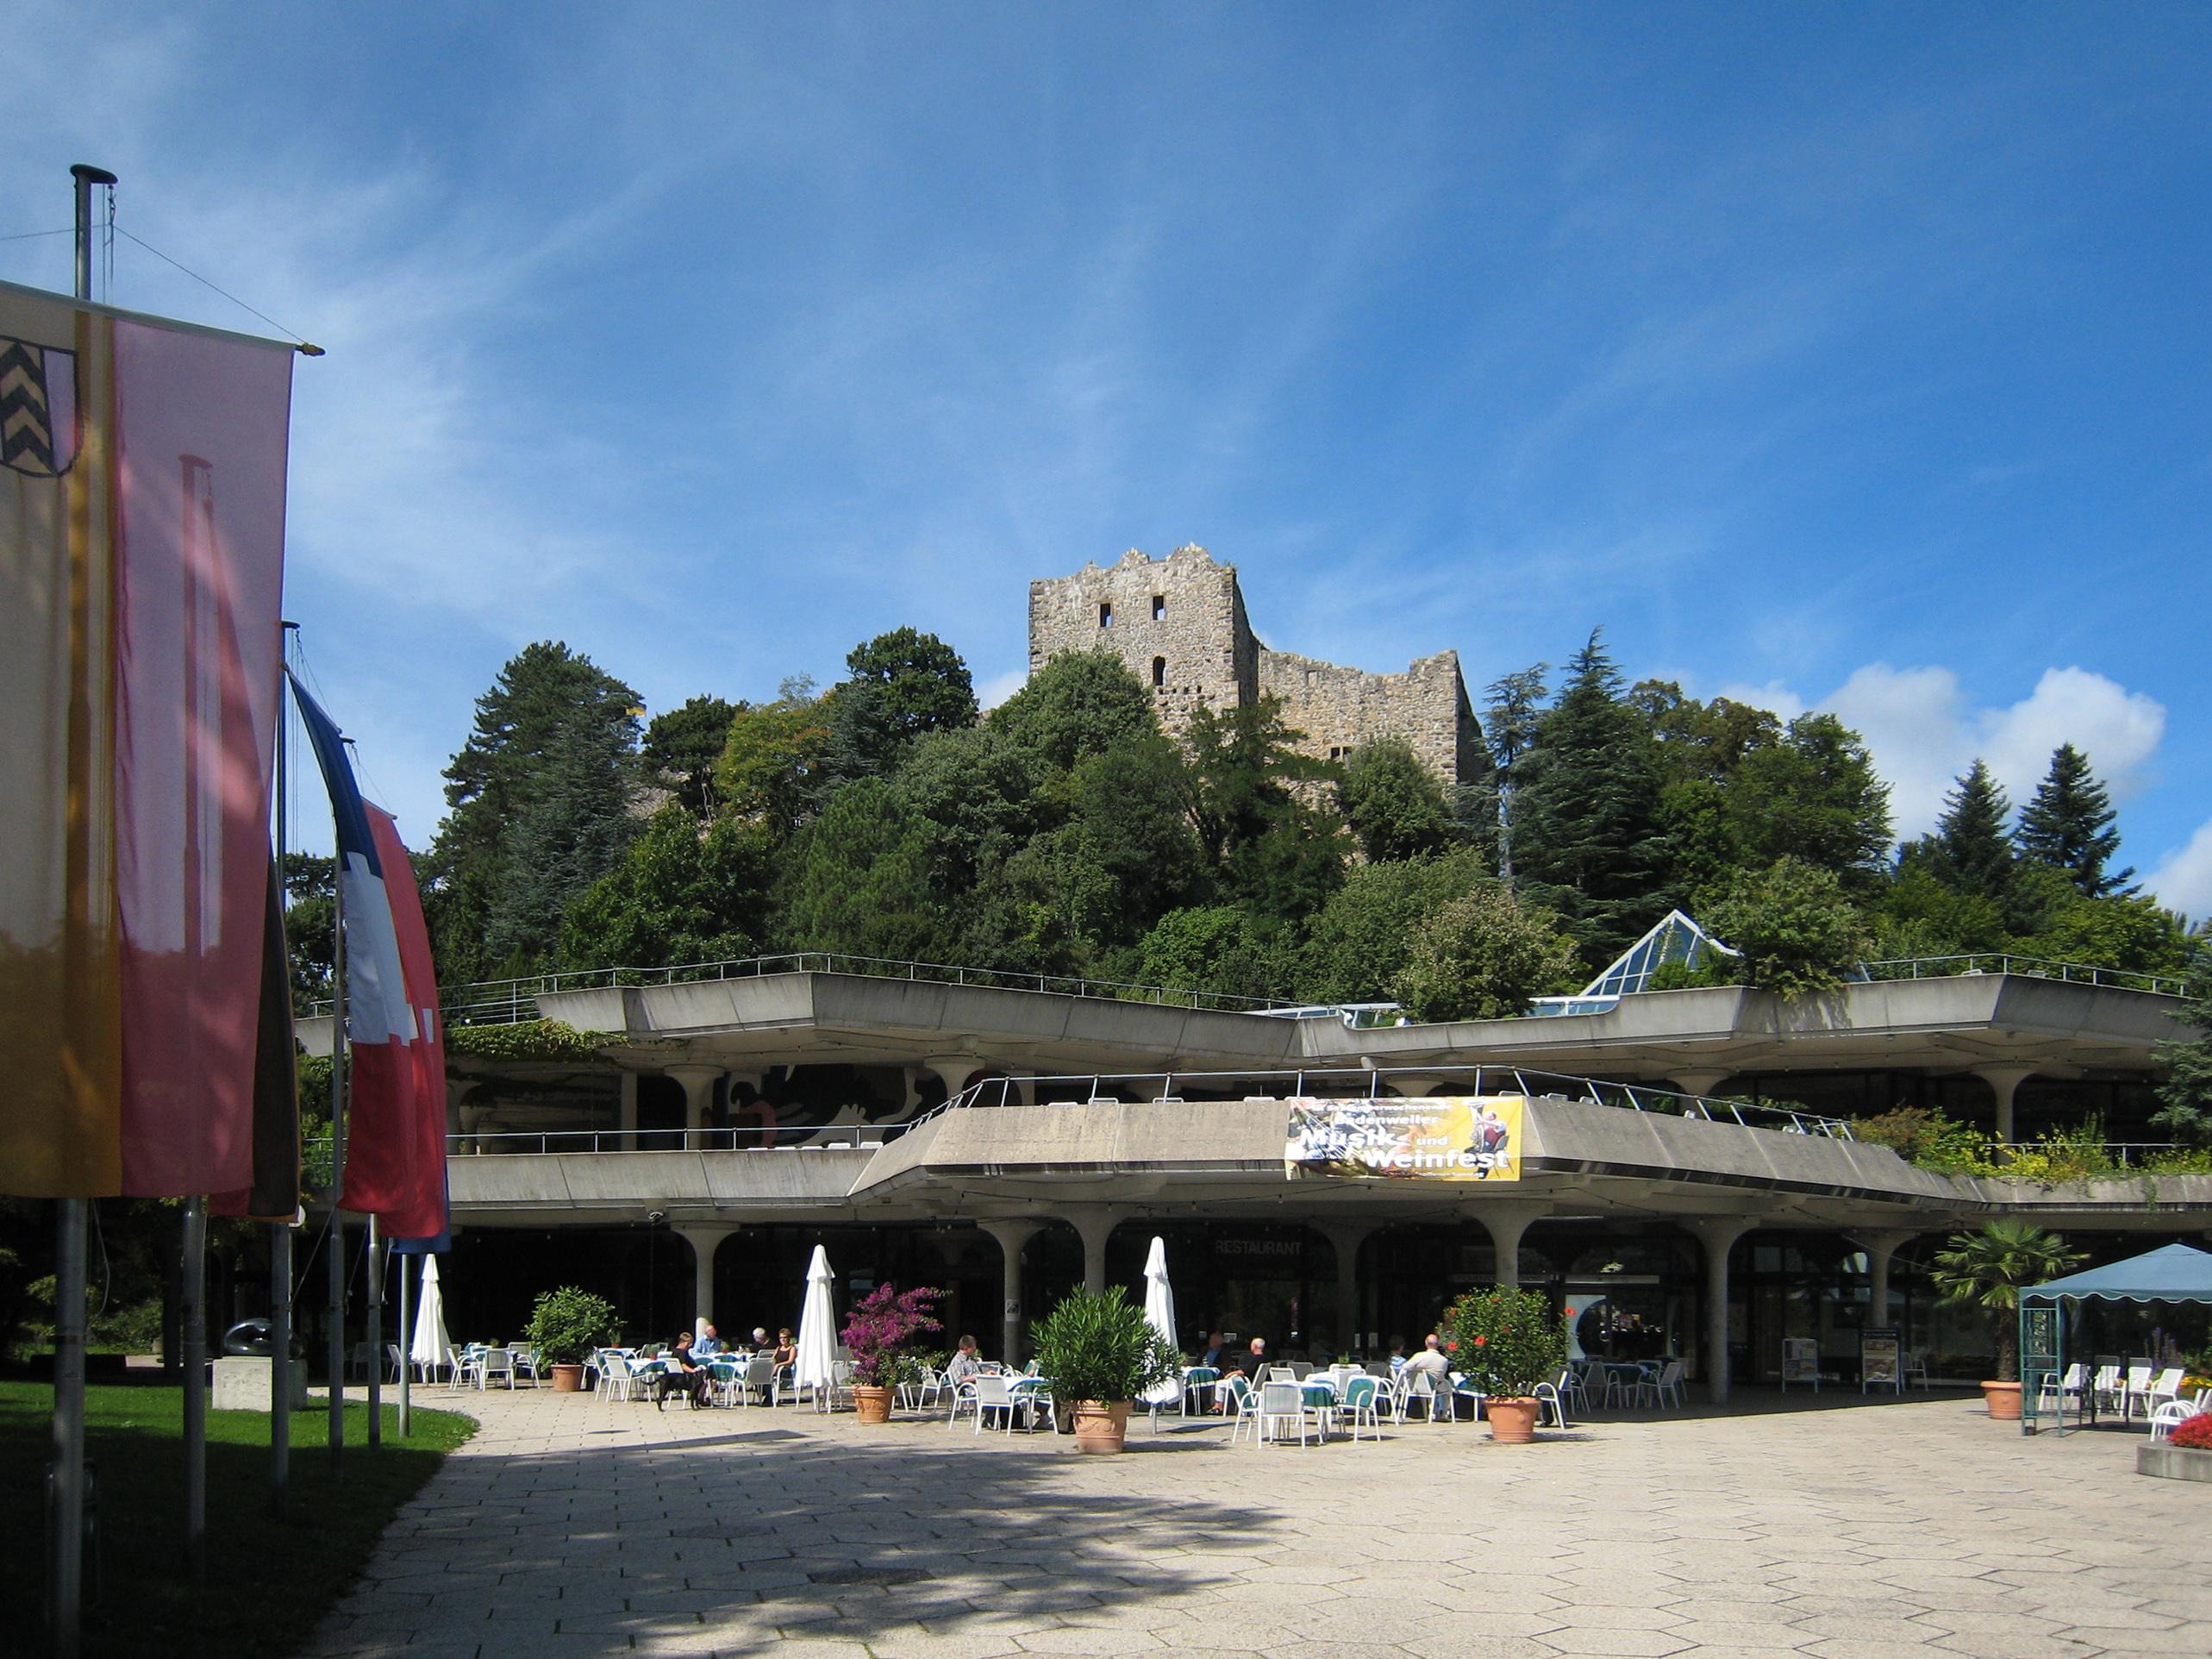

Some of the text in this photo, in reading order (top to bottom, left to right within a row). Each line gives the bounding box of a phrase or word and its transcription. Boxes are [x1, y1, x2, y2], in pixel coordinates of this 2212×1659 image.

[1415, 1136, 1448, 1146] und
[1363, 1149, 1509, 1168] Weinfest
[1215, 1239, 1303, 1256] RESTAURANT
